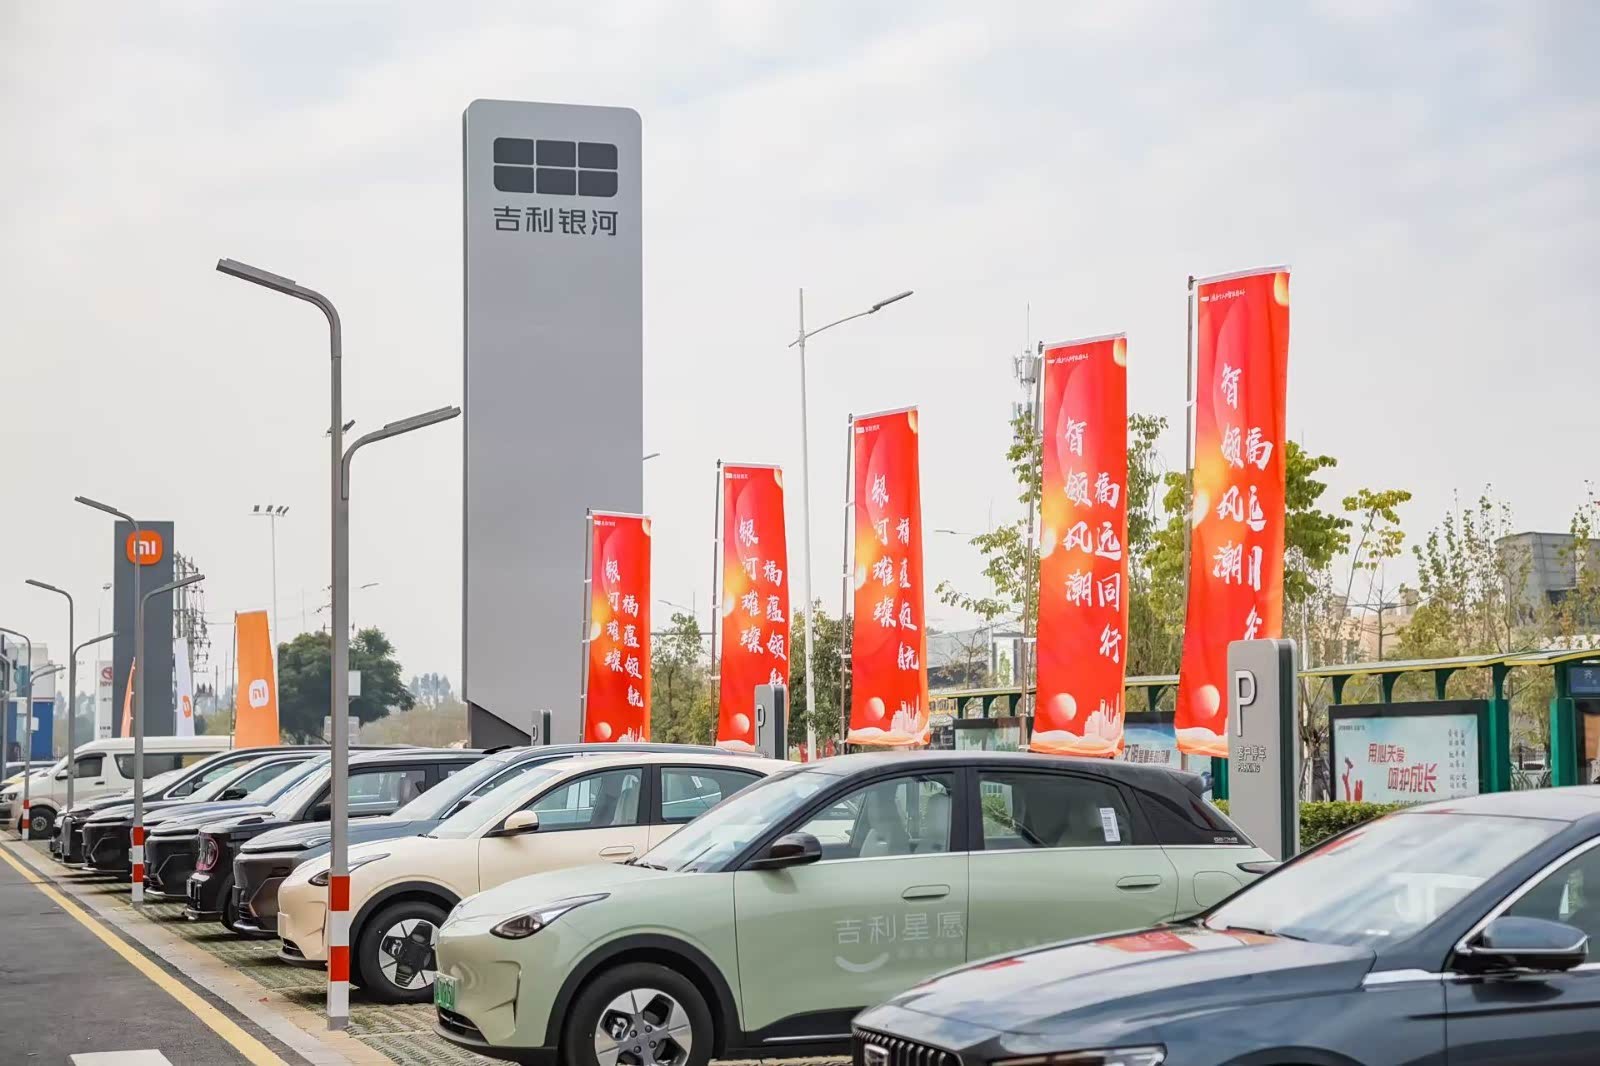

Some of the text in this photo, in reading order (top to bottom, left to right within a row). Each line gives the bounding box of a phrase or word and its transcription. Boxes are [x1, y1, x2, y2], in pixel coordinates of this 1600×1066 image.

[493, 206, 618, 236] 吉利银河
[1062, 416, 1093, 607] 智领风潮
[1212, 362, 1244, 585] 智领风潮
[738, 518, 764, 654] 银河璀璨
[871, 473, 897, 628] 银河璀璨
[1094, 472, 1122, 664] 福远同行
[604, 557, 624, 672] 银河璀璨
[622, 594, 644, 707] 福蕴领航
[756, 704, 766, 746] P
[1235, 670, 1257, 737] P
[1387, 763, 1438, 792] 呵护成长
[835, 911, 965, 944] 吉利星愿
